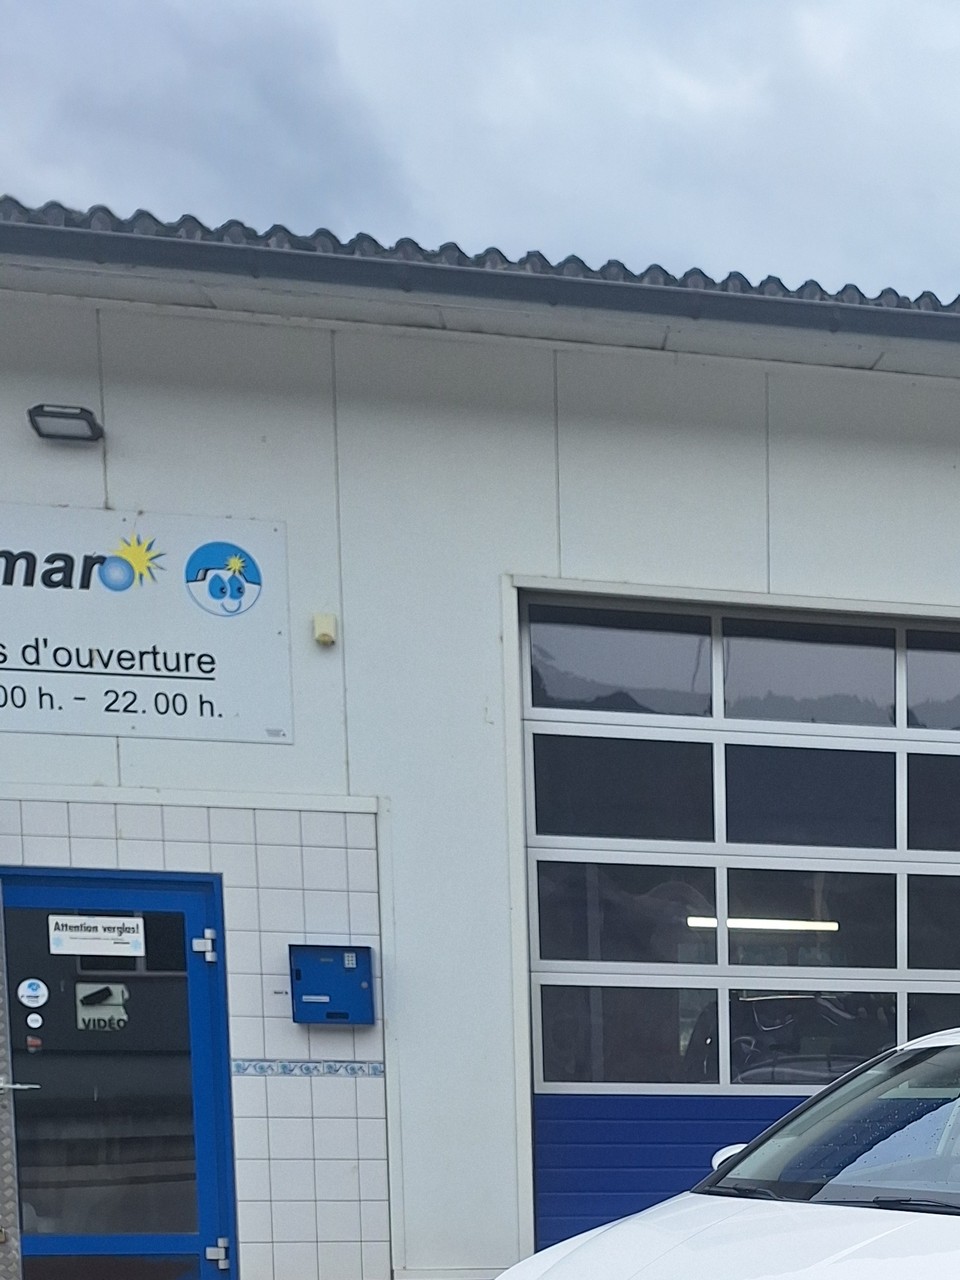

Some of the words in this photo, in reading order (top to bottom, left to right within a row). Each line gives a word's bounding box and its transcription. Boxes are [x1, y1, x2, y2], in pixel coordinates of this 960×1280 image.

[21, 637, 216, 674] d'ouverture
[38, 686, 63, 710] h.
[199, 694, 223, 717] h.
[53, 920, 99, 933] Attention
[102, 921, 140, 936] verglas!
[82, 1015, 127, 1030] VIDÉO
